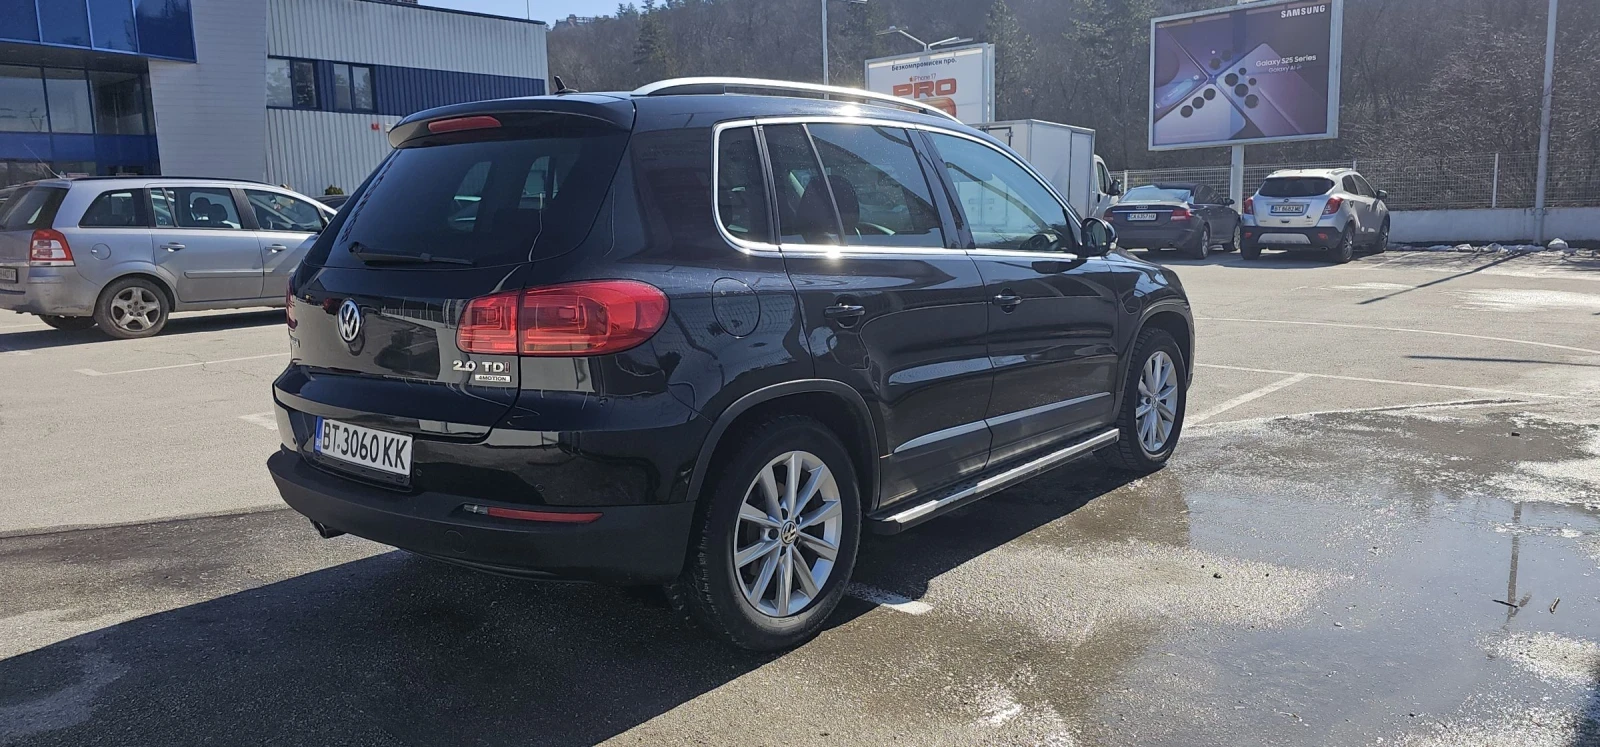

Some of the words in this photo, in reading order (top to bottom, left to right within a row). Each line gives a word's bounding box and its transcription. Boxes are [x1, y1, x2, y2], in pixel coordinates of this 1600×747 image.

[1280, 4, 1326, 18] SAMSUNG
[891, 60, 943, 71] Безкомпромисен
[943, 57, 957, 65] про.
[1255, 59, 1281, 67] Galaxy
[1281, 56, 1294, 64] S25
[1294, 54, 1317, 63] Series
[913, 74, 931, 82] iPhone
[892, 78, 957, 99] PRO
[452, 360, 476, 372] 2.0
[382, 436, 408, 470] KK
